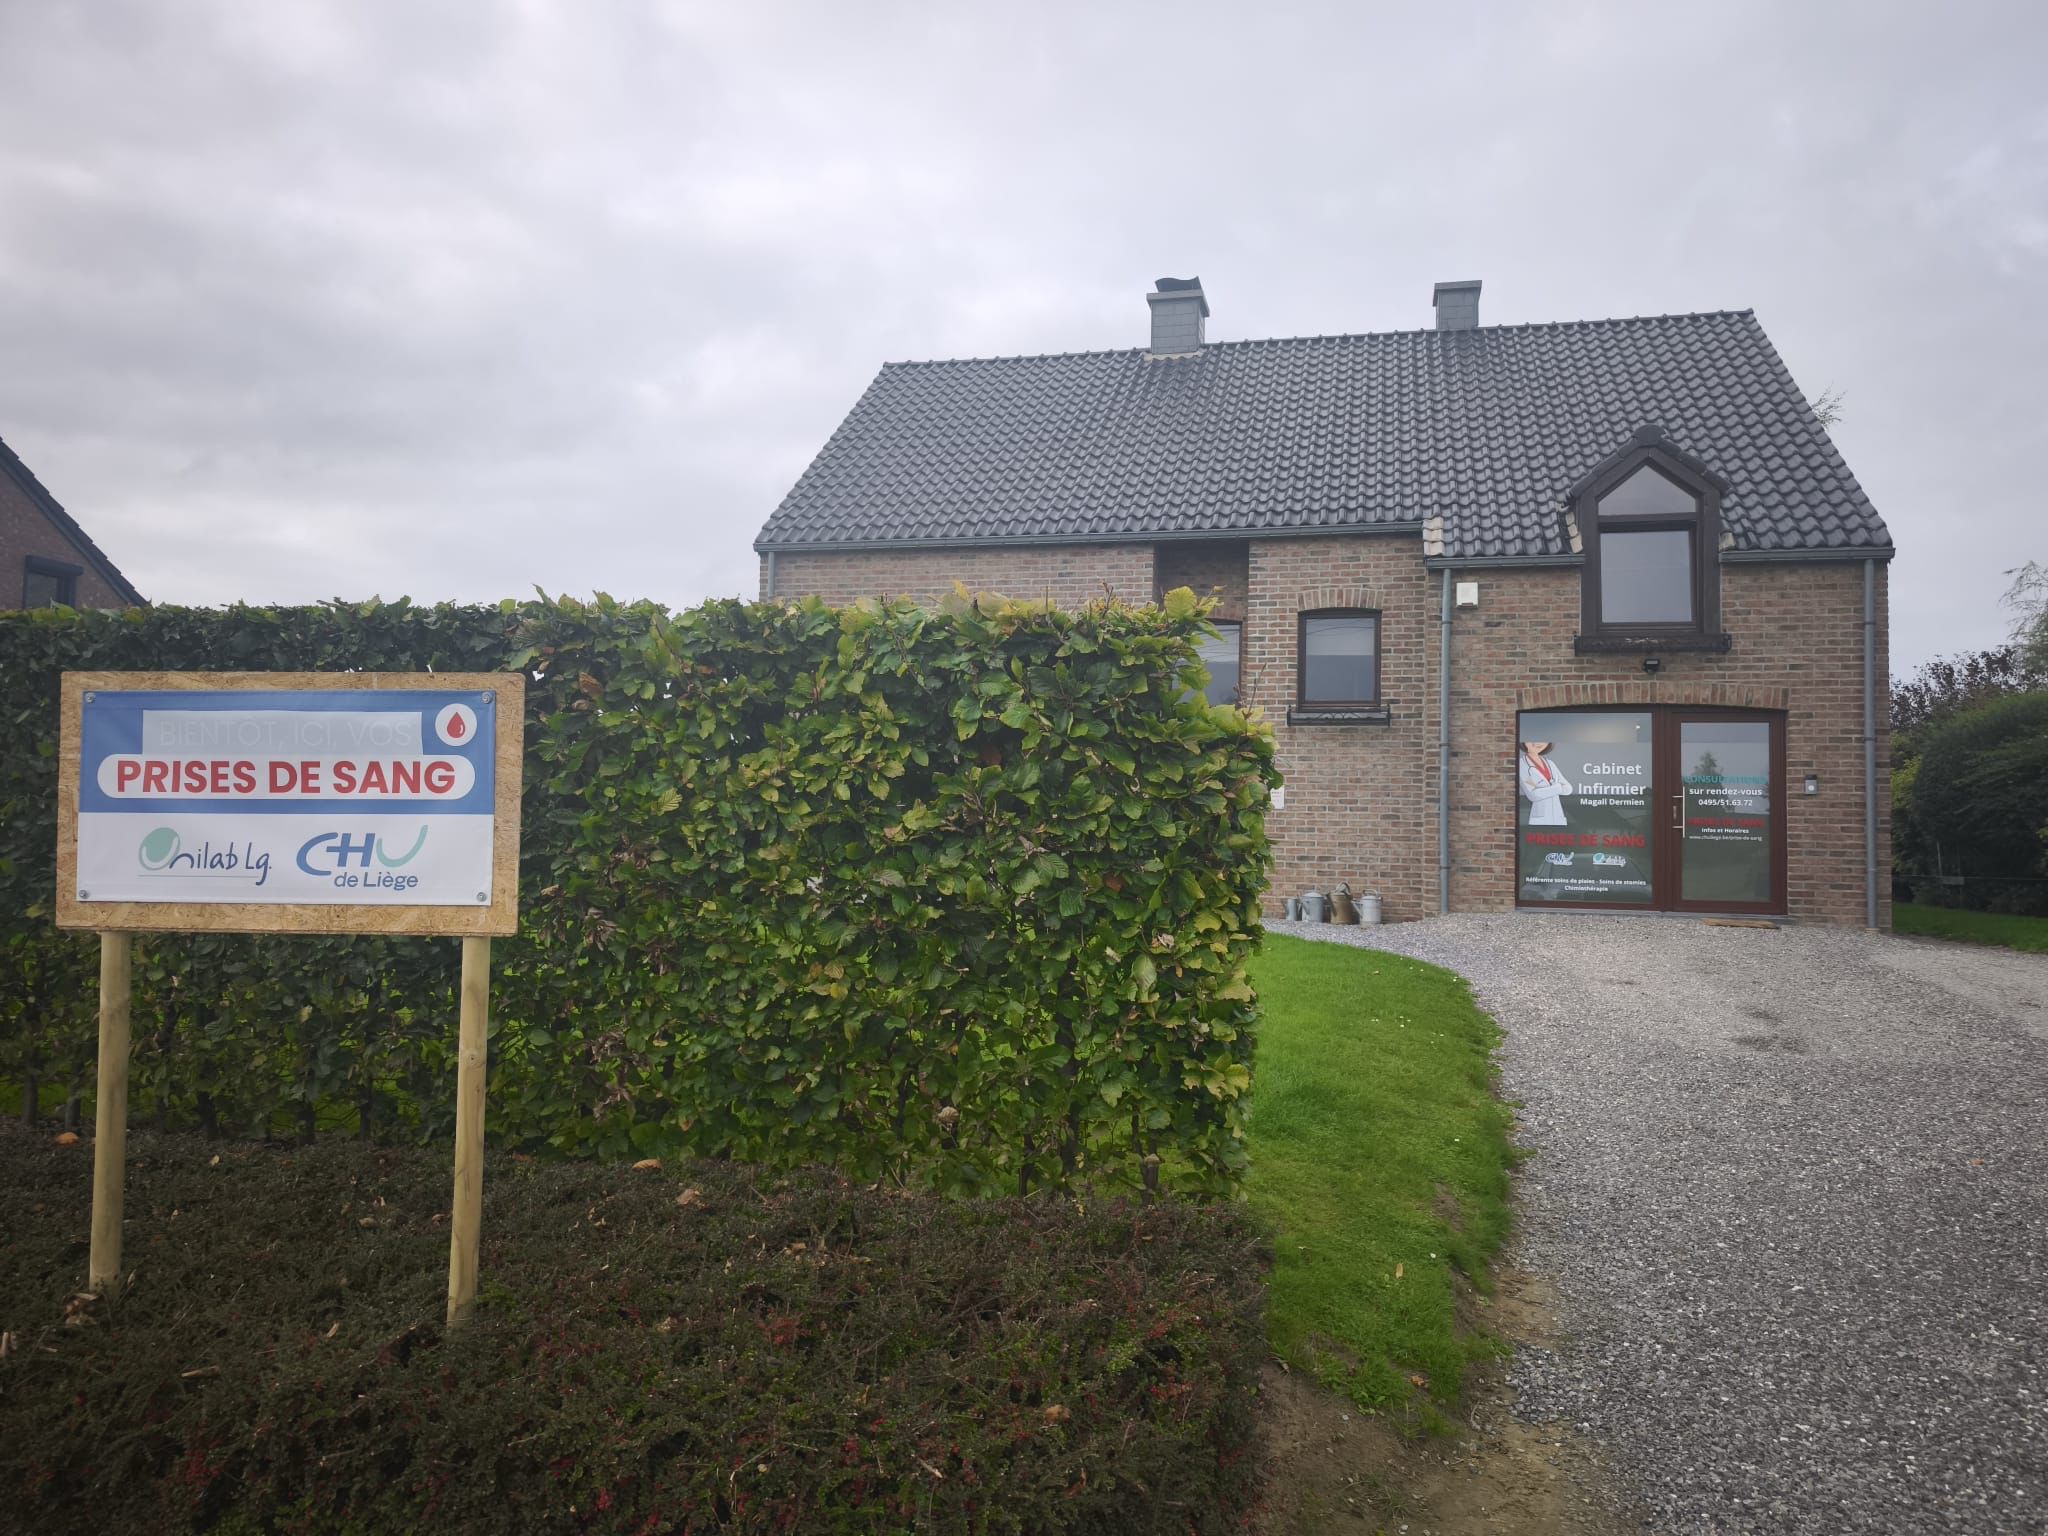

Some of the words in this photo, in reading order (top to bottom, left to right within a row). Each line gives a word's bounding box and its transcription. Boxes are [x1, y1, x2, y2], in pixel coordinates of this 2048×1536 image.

[1583, 763, 1642, 775] Cabinet
[117, 760, 256, 792] PRISES
[268, 761, 321, 793] DE
[333, 761, 455, 794] SANG
[1578, 783, 1646, 795] Infirmier
[1706, 787, 1763, 796] rendez-vous
[1609, 798, 1645, 806] Dermien
[1698, 799, 1753, 807] 0495/51.63.72
[1580, 833, 1599, 847] DE
[1603, 834, 1646, 848] SANG
[296, 825, 428, 876] CHU
[334, 872, 359, 888] de
[364, 871, 419, 890] Liège
